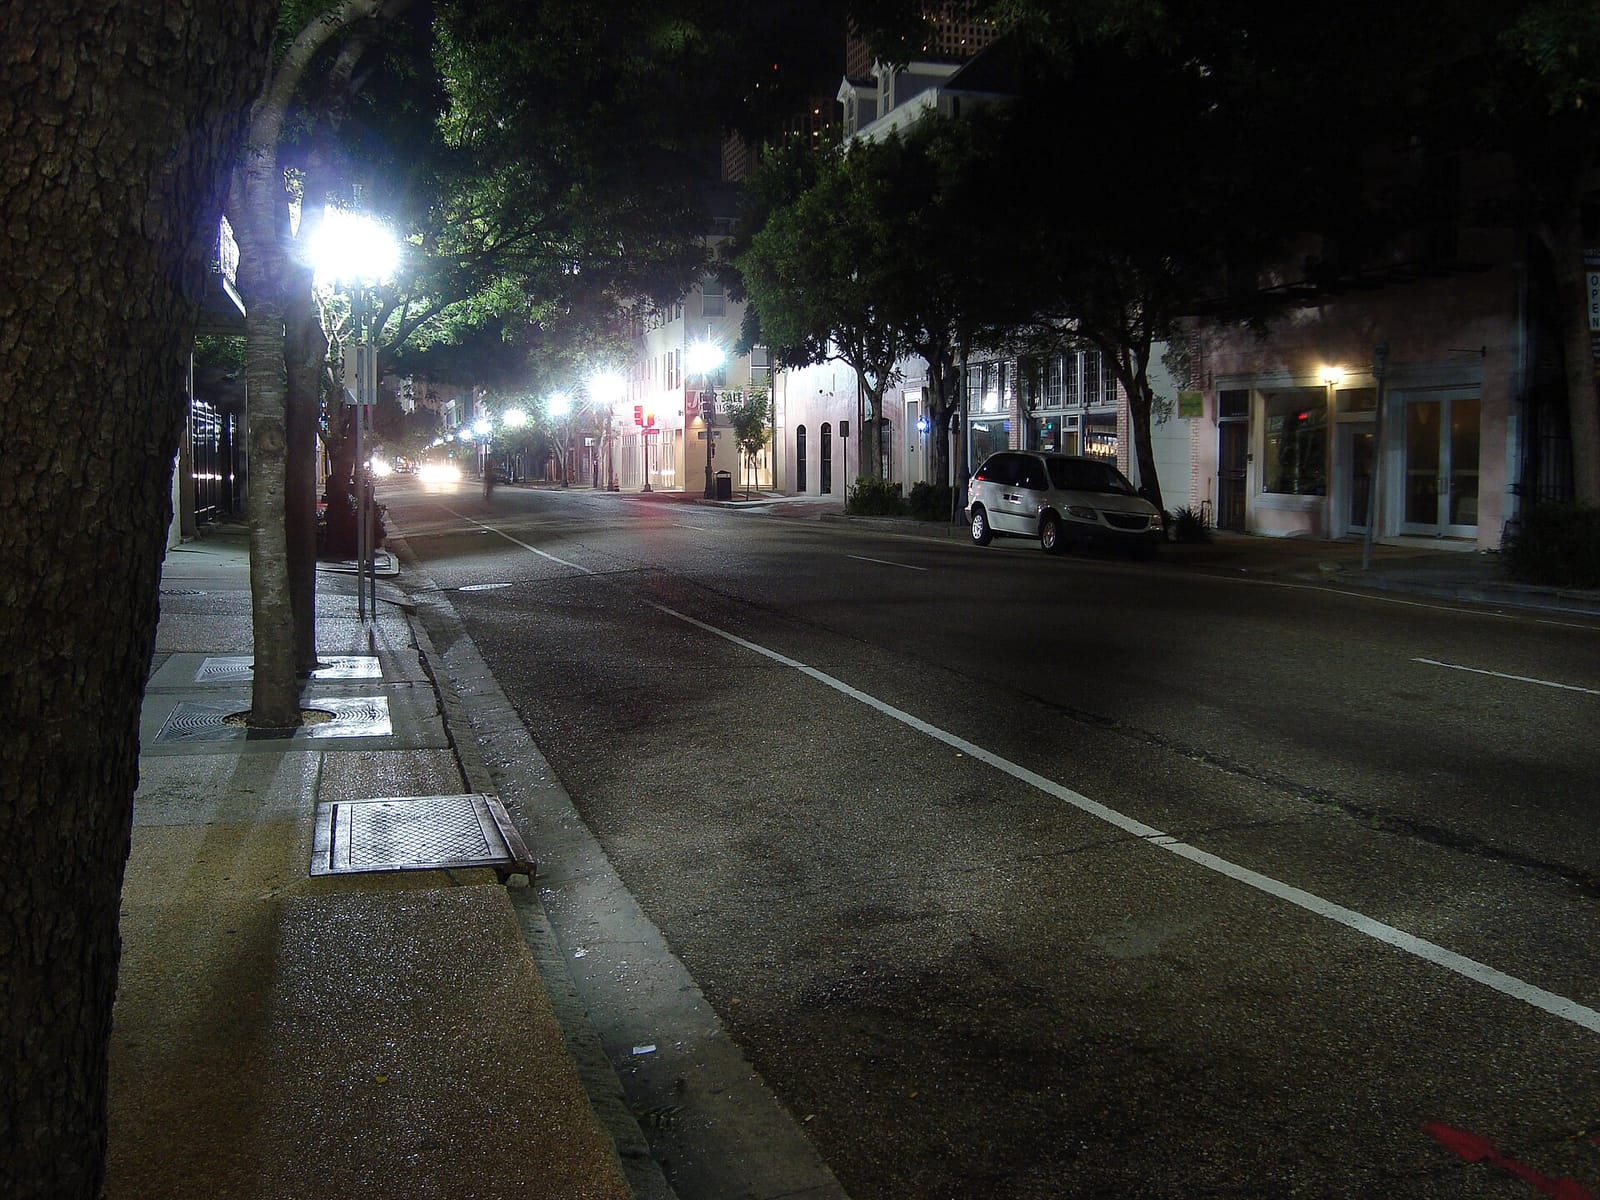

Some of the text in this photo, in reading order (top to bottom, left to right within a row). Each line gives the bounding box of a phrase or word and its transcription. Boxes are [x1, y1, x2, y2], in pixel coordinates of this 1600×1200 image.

[1591, 275, 1599, 327] OPEN
[699, 391, 743, 403] FR SALE
